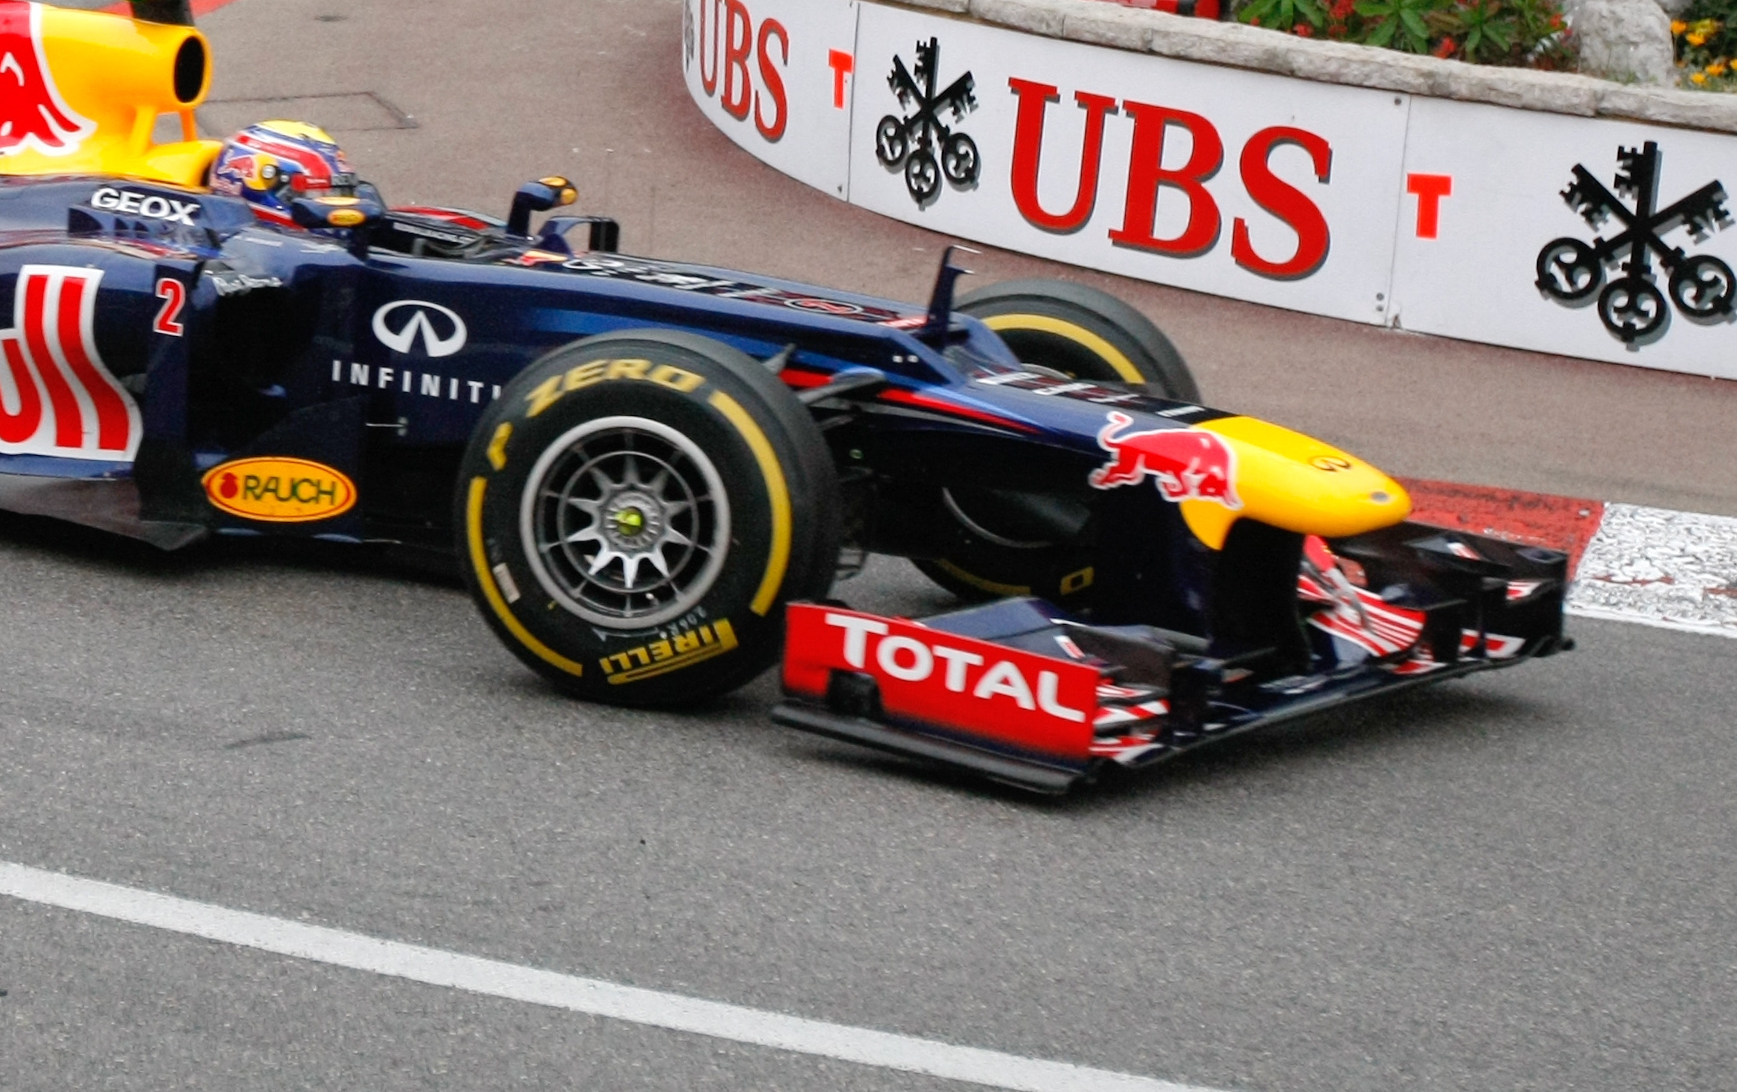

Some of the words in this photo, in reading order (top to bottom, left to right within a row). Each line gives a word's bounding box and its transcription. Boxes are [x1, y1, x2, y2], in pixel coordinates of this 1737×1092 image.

[90, 186, 200, 227] GEOX
[1007, 76, 1332, 281] UBS
[153, 278, 185, 337] 2
[331, 359, 501, 404] INFINITI
[524, 358, 707, 418] ZERO
[243, 475, 337, 506] RAUCH
[598, 617, 739, 686] PIRELLI
[825, 613, 1086, 723] TOTAL
